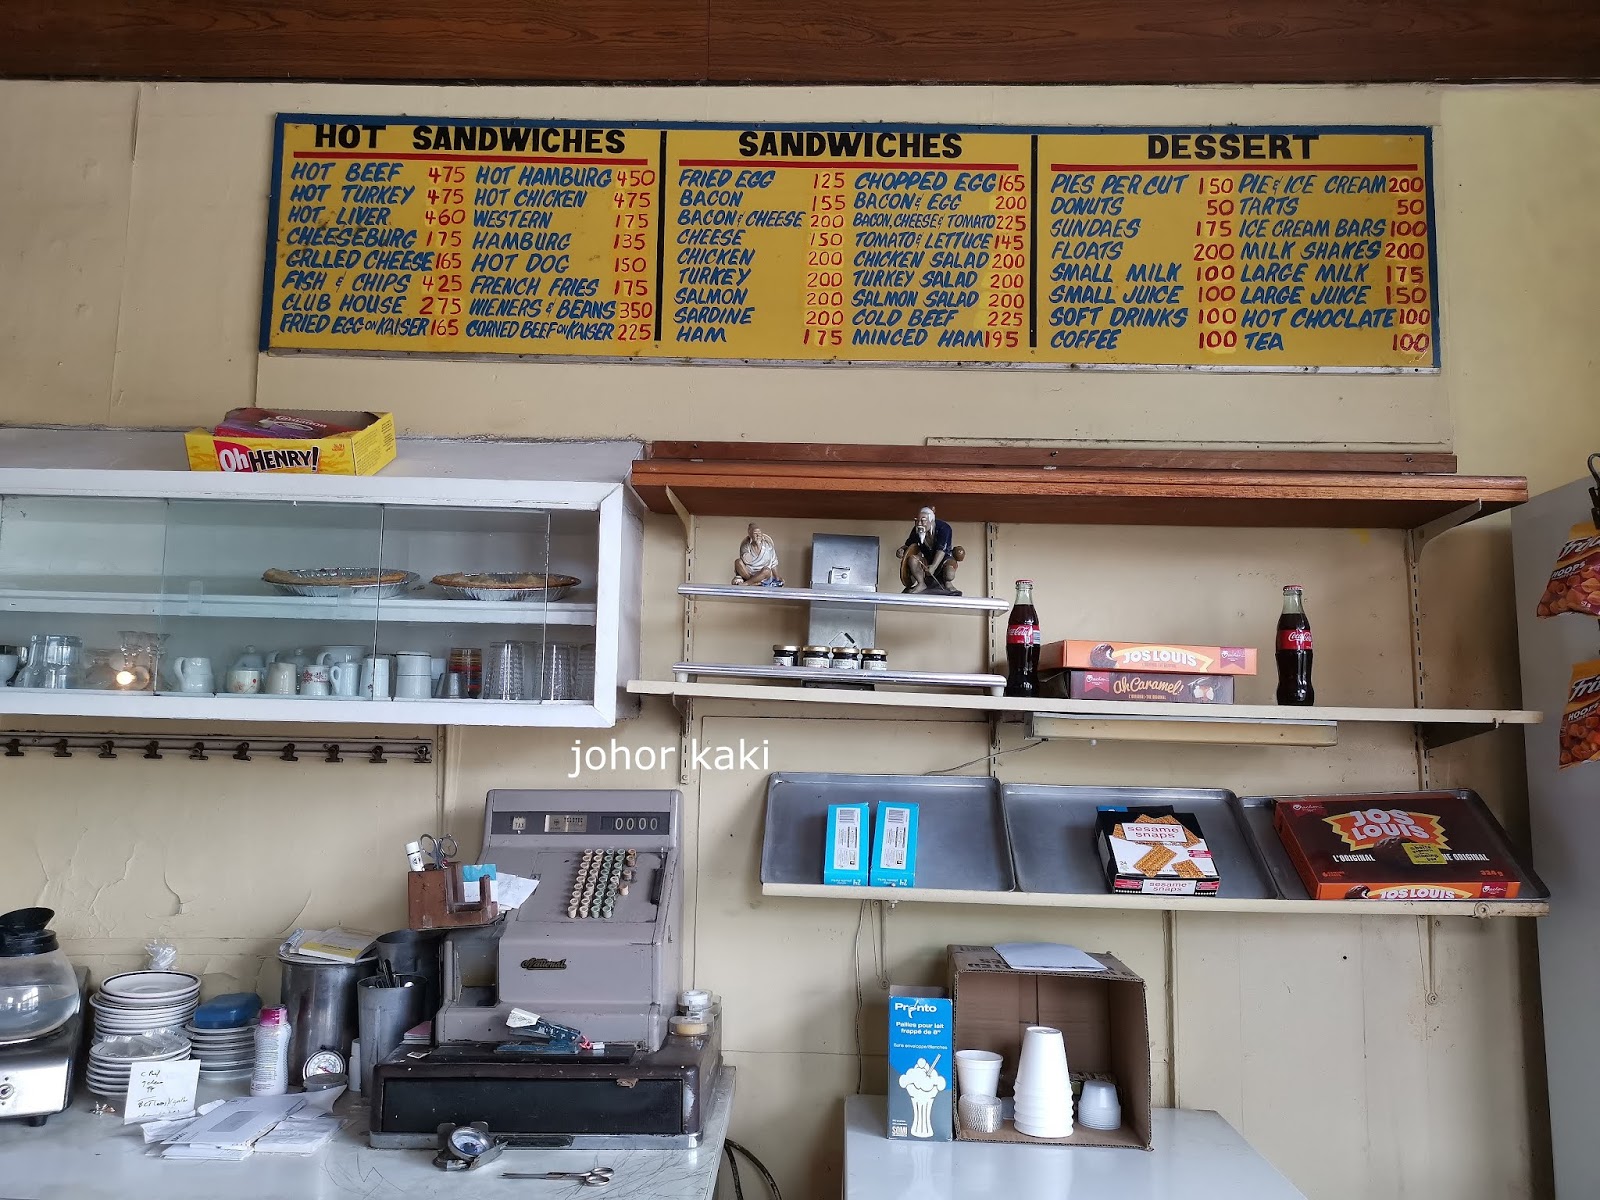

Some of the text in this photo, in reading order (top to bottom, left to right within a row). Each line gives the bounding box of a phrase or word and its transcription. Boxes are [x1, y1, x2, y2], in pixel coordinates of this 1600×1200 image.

[314, 125, 626, 153] HOT SANDWICHES
[738, 131, 962, 159] SANDWICHES
[1147, 135, 1320, 160] DESSERT
[291, 162, 466, 183] HOT BEEF 475
[475, 166, 612, 187] HOT HAMBURG
[678, 169, 845, 189] FRIED EGG 125
[854, 172, 996, 192] CHOPPED EGG
[1050, 174, 1234, 194] PIES PER CUT 150
[1239, 174, 1387, 194] PIE ICE CREAM
[290, 185, 464, 205] HOT TURKEY 475
[474, 189, 587, 207] HOT CHICKEN
[679, 190, 846, 211] BACON 155
[854, 193, 962, 211] BACON EGG
[1050, 197, 1234, 216] DONUTS 50
[1239, 197, 1299, 215] TARTS
[288, 206, 465, 226] HOT LIVER 460
[473, 211, 553, 228] WESTERN
[677, 211, 845, 228] BACON CHEESE 200
[892, 213, 937, 228] CHEESE
[947, 214, 996, 229] TOMATO
[286, 228, 462, 248] CHEESEBURG 175
[676, 229, 843, 247] CHEESE 150
[1050, 219, 1232, 238] SUNDAES 175
[1239, 219, 1387, 238] ICE CREAM BARS
[472, 233, 571, 250] HAMBURG
[854, 232, 993, 249] TOMATO LETTUCE
[1240, 240, 1382, 260] MILK SHAKES
[676, 249, 843, 266] CHICKEN 200
[853, 250, 990, 269] CHICKEN SALAD
[1050, 241, 1234, 261] FLOATS 200
[363, 252, 435, 270] CHEESE
[436, 253, 462, 269] 165
[471, 254, 569, 273] HOT DOG
[282, 271, 462, 292] FISH CHIPS 425
[678, 268, 843, 288] TURKEY 200
[853, 270, 978, 288] TURKEY SALAD
[1050, 263, 1235, 283] SMALL MILK 100
[1239, 264, 1369, 283] LARGE MILK
[470, 276, 599, 297] FRENCH FRIES
[1048, 285, 1235, 304] SMALL JUICE 100
[1239, 286, 1371, 305] LARGE JUICE
[281, 293, 462, 315] CLUB HOUSE 275
[673, 287, 843, 306] SALMON 200
[851, 290, 980, 307] SALMON SALAD
[469, 299, 617, 319] WIENERS BEANS
[673, 307, 844, 325] SARDINE 200
[851, 310, 959, 327] COLD BEEF
[1048, 307, 1237, 327] SOFT DRINKS 100
[1240, 307, 1397, 329] HOT CHOCLATE
[280, 314, 459, 336] FRIED EGG KAISER 165
[466, 322, 614, 340] CORNED BEEF KAISER
[676, 327, 843, 345] HAM 175
[852, 329, 984, 346] MINCED HAM
[1050, 329, 1237, 350] COFFEE 100
[1245, 332, 1284, 350] TEA
[219, 446, 320, 474] Oh HENRY!
[1551, 560, 1587, 578] HOOPS
[1123, 649, 1197, 667] JOS LOUIS
[1132, 677, 1184, 696] Caramel!
[1350, 808, 1415, 827] JOS
[1127, 825, 1178, 833] sesame
[1350, 824, 1433, 841] LOUIS
[1332, 854, 1376, 862] L'ORIGINAL
[1454, 853, 1490, 861] ORIGINAL
[1380, 888, 1455, 898] JOS LOUIS
[894, 1001, 937, 1018] Pronto
